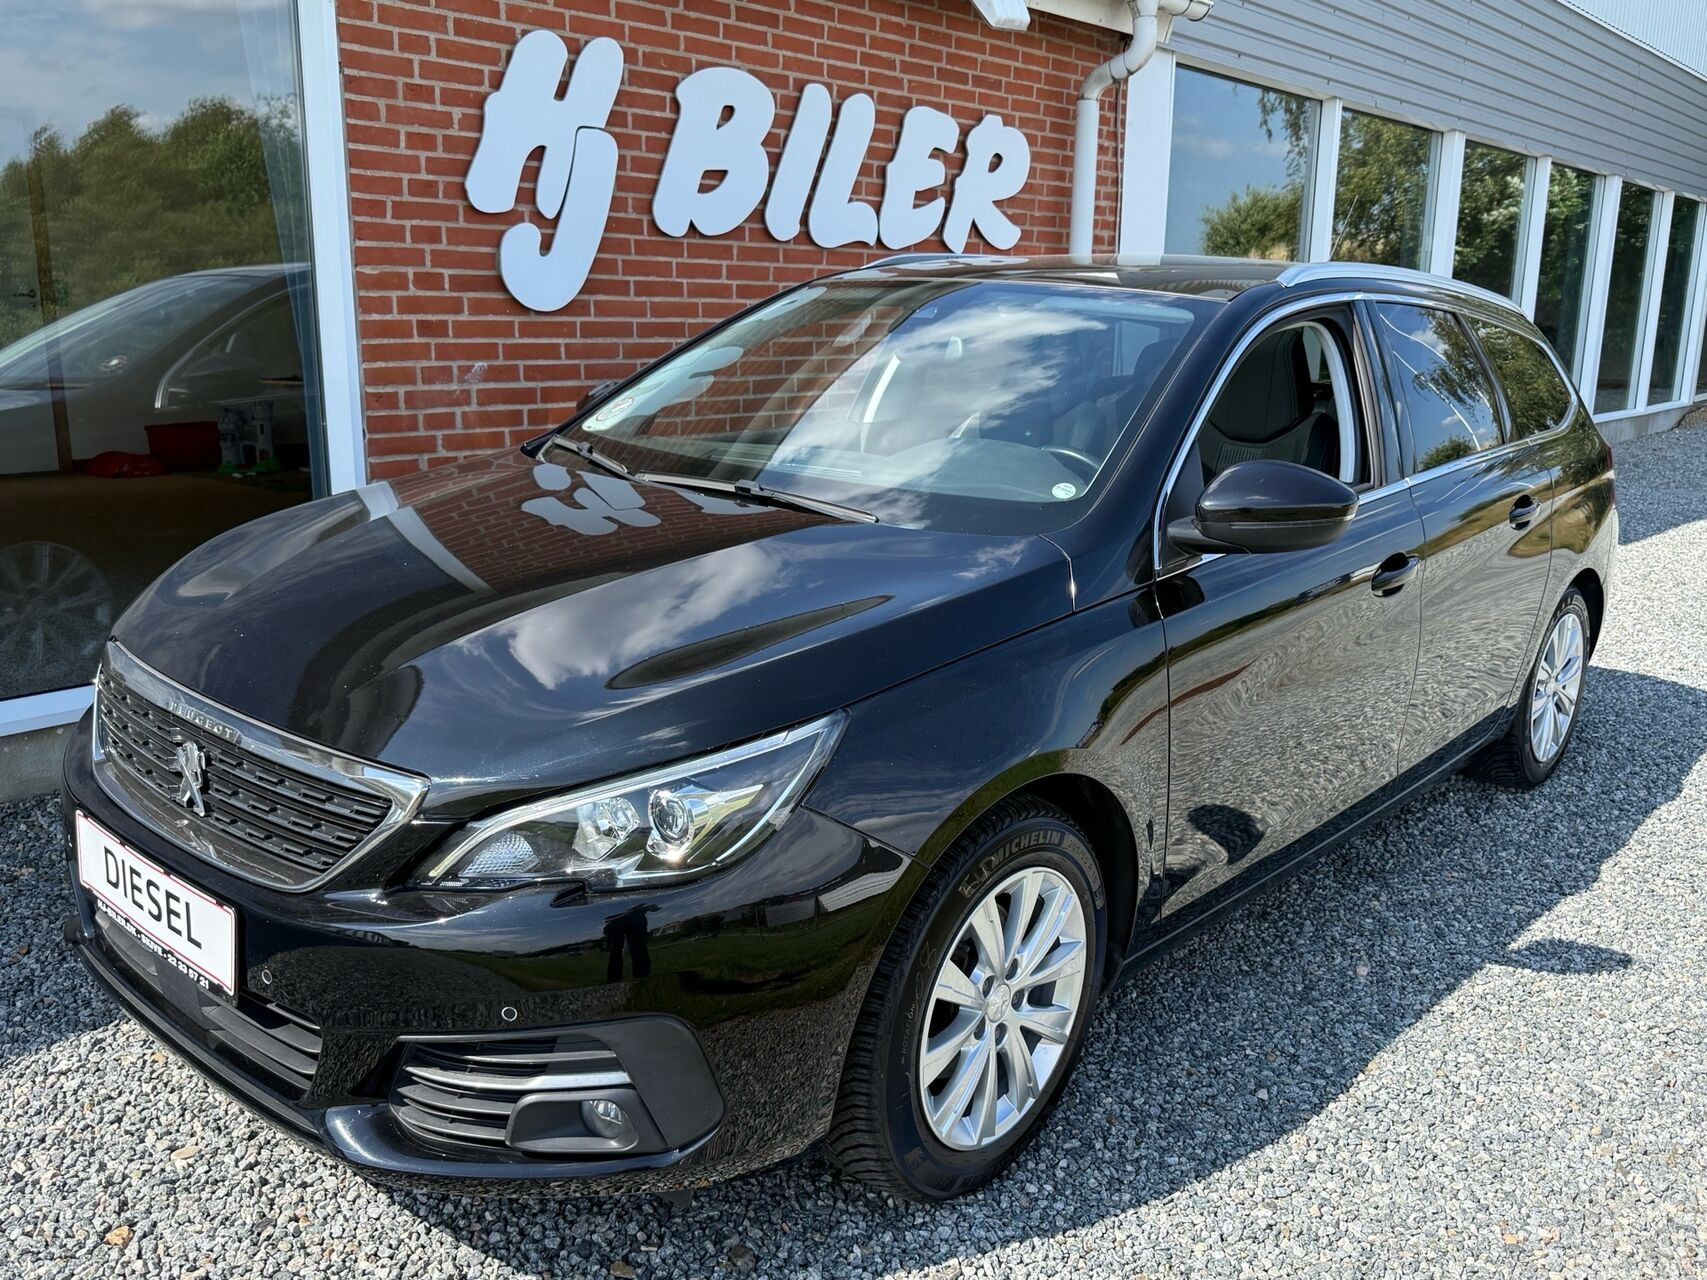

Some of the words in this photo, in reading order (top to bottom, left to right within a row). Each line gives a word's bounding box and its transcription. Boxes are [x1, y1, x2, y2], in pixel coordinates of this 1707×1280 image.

[652, 67, 1032, 254] BILER
[169, 701, 233, 739] PEUGEOT
[992, 830, 1062, 867] MICHELIN
[104, 845, 203, 951] DIESEL
[199, 976, 209, 990] 21
